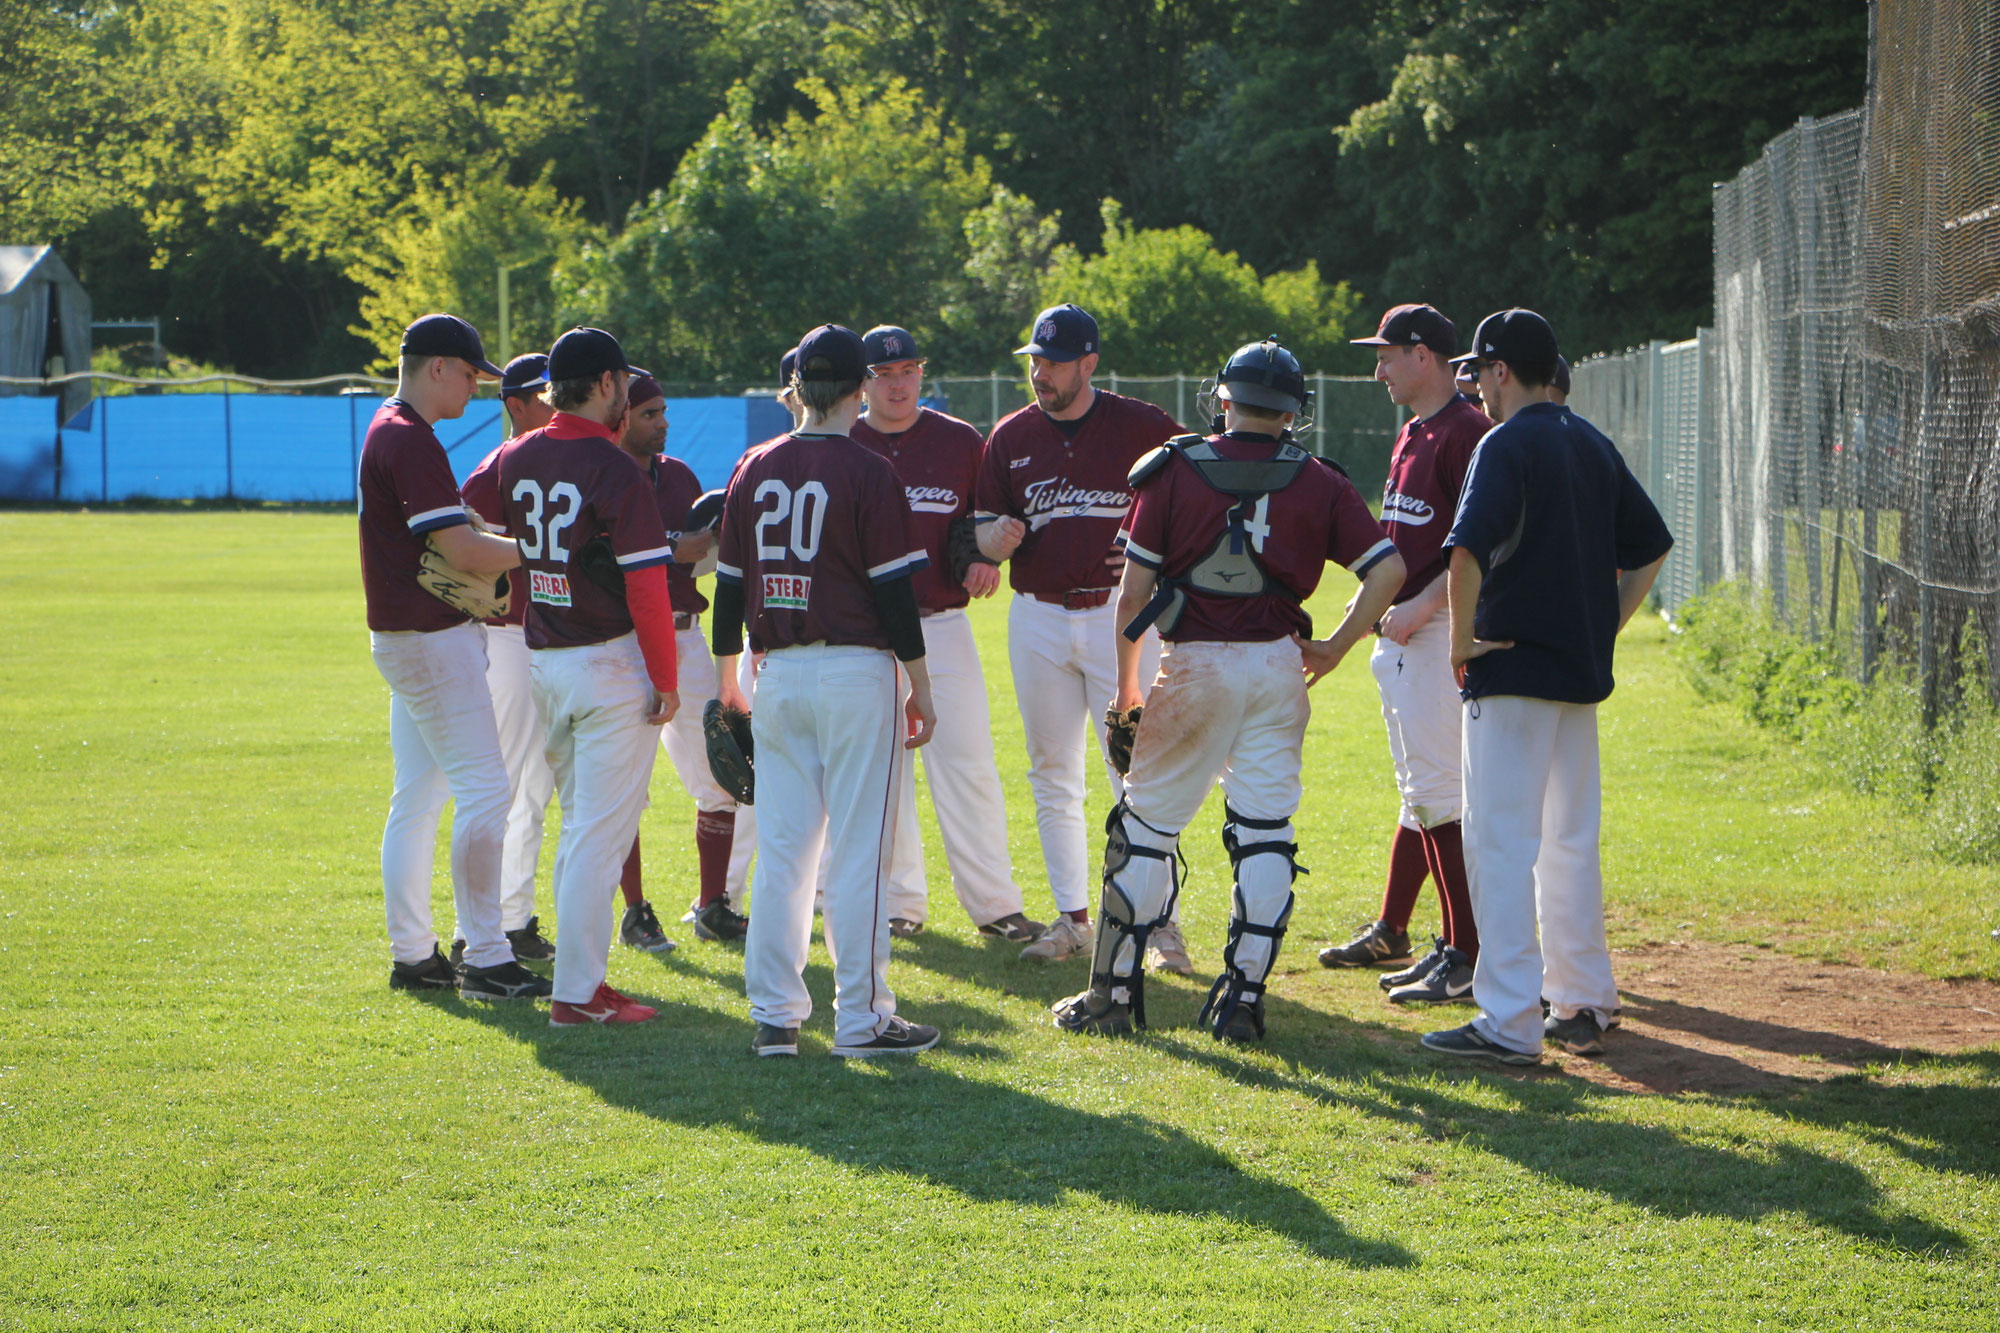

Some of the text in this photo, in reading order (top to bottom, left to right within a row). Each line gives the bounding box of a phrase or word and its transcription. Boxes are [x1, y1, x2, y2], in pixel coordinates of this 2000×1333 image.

[512, 479, 583, 564] 32
[753, 479, 829, 562] 20
[1226, 492, 1271, 554] 4
